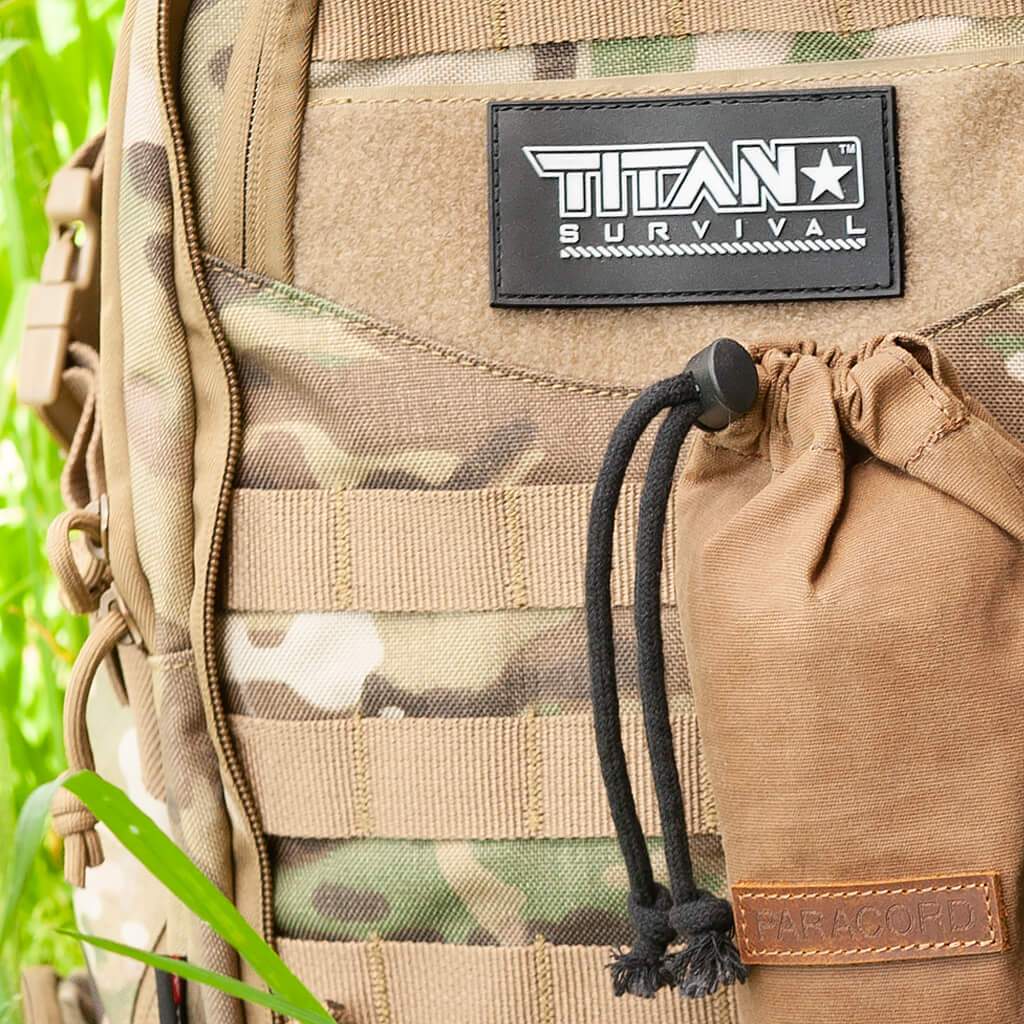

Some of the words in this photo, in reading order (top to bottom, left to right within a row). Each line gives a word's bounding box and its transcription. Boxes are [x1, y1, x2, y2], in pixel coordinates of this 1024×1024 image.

[521, 138, 801, 218] TITAN
[559, 214, 867, 244] SURVIVAL
[755, 899, 977, 942] PARACORD
